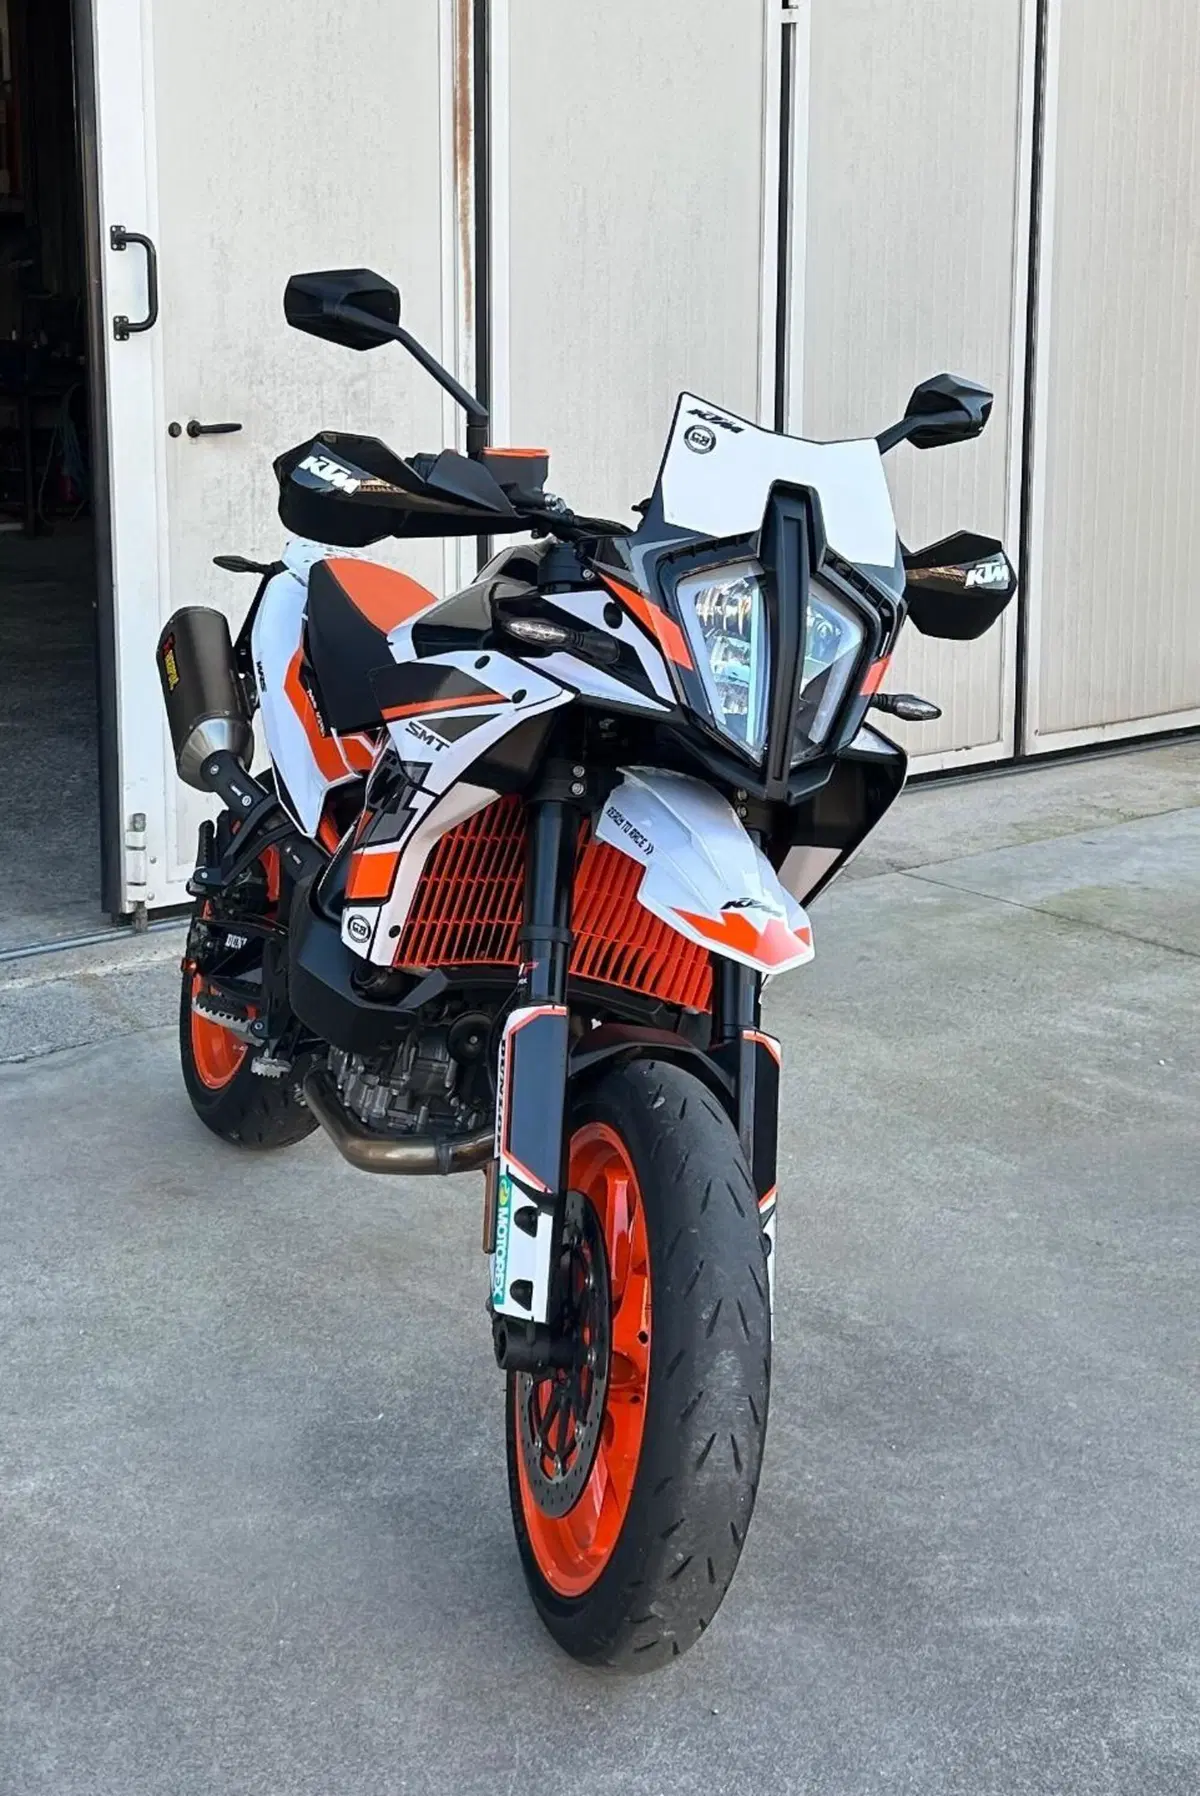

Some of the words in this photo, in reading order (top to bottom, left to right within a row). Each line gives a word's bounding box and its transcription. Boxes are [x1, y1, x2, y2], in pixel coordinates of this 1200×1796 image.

[686, 408, 745, 434] KTM
[298, 455, 361, 495] KTM
[965, 562, 1010, 587] KTM
[404, 720, 450, 752] SMT
[605, 806, 626, 827] READY
[620, 820, 633, 834] TO
[628, 827, 648, 848] RACE
[493, 1206, 510, 1298] MOTOREX
